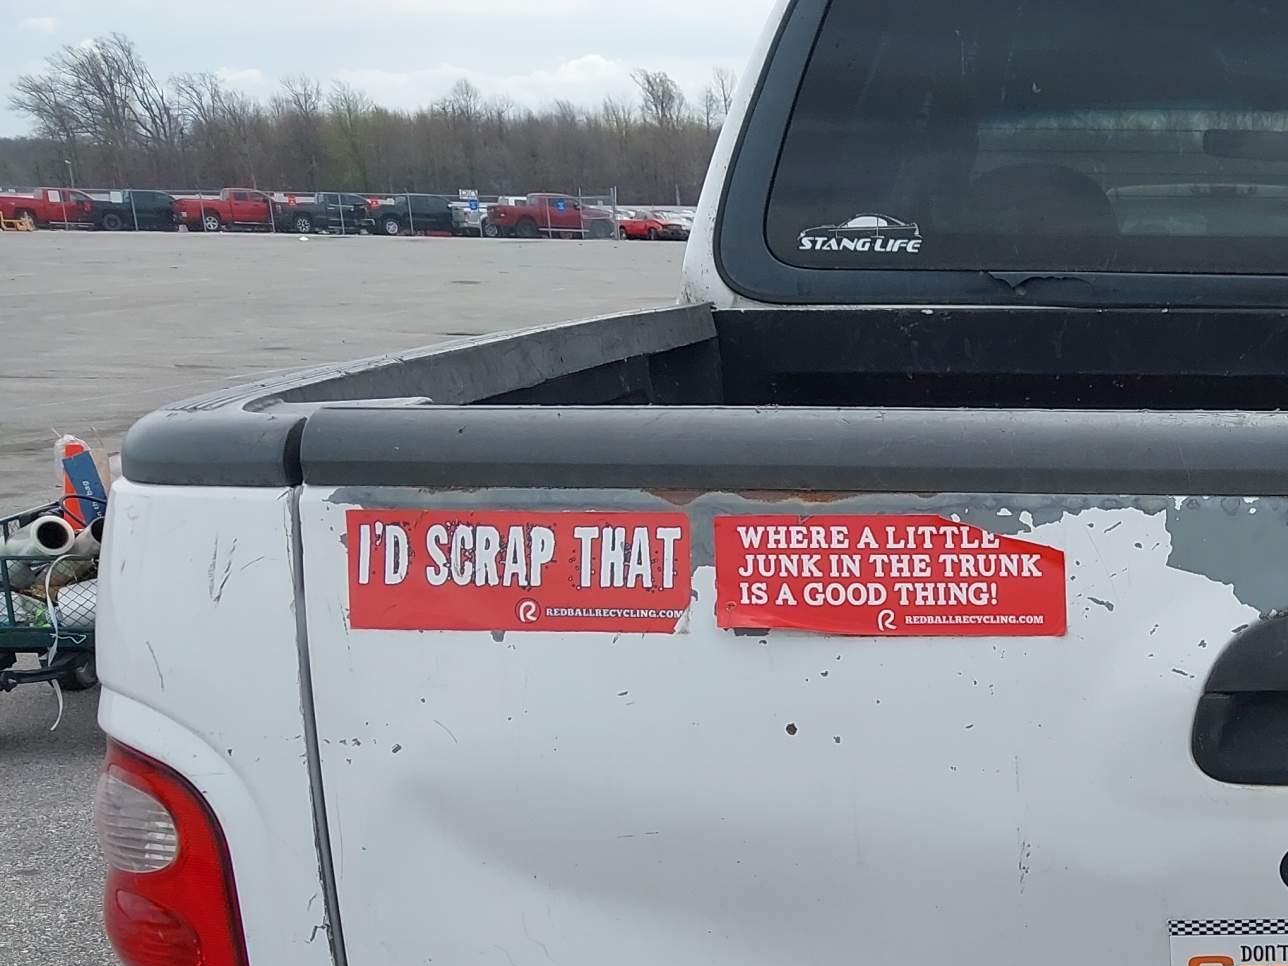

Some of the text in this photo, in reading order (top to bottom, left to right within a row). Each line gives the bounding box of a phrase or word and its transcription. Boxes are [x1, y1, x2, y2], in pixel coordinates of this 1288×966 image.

[799, 237, 922, 253] STANG LIFE
[737, 526, 1000, 549] WHERE A LITTLE
[358, 520, 682, 589] I'D SCRAP THAT
[738, 554, 1042, 577] JUNK IN THE TRUNK
[740, 582, 998, 606] IS A GOOD THING!
[546, 608, 683, 619] REDBALLRECYCLING.COM
[905, 614, 1044, 625] REDBALLRECYCLING.COM
